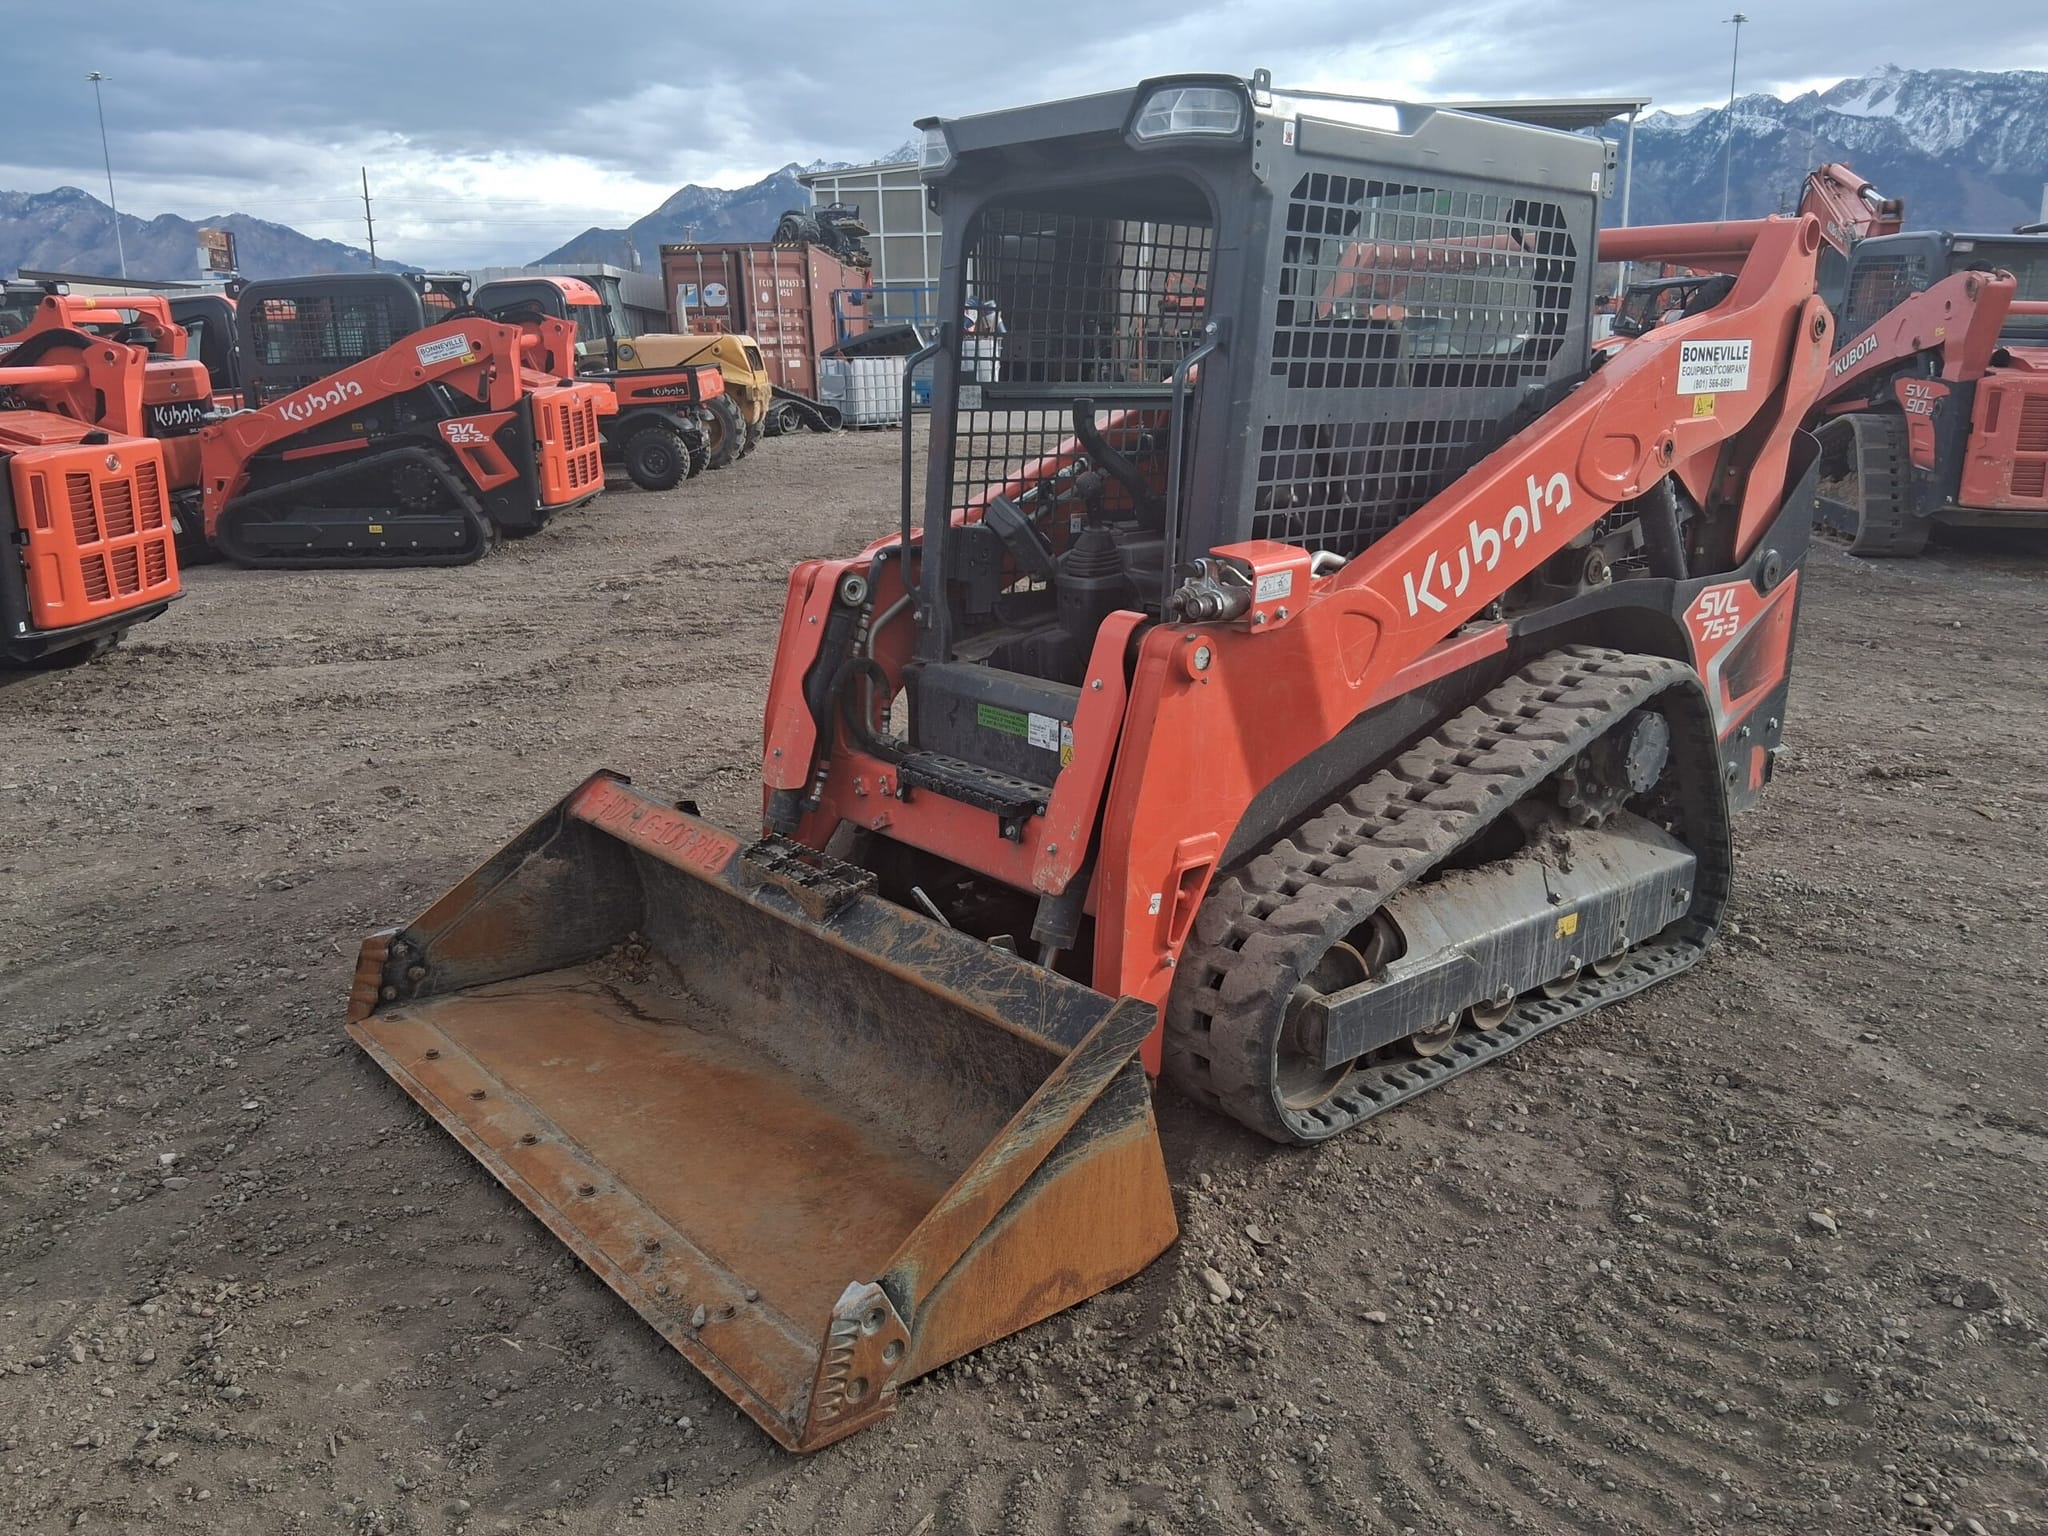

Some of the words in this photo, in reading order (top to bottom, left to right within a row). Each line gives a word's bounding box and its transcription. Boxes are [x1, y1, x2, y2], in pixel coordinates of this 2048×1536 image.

[1682, 345, 1749, 362] BONNEVILLE
[1834, 333, 1879, 377] KUBOTA
[1681, 365, 1717, 376] EQUIPMENT
[1717, 363, 1747, 375] COMPANY
[653, 386, 685, 396] Kubota
[1693, 378, 1708, 390] (801)
[1904, 383, 1932, 400] SVL
[279, 380, 364, 422] Kubota
[154, 403, 202, 427] Kubota
[446, 423, 481, 435] SVL
[1403, 472, 1572, 617] Kubota
[1696, 588, 1740, 620] SVL
[1701, 615, 1740, 642] 75-3
